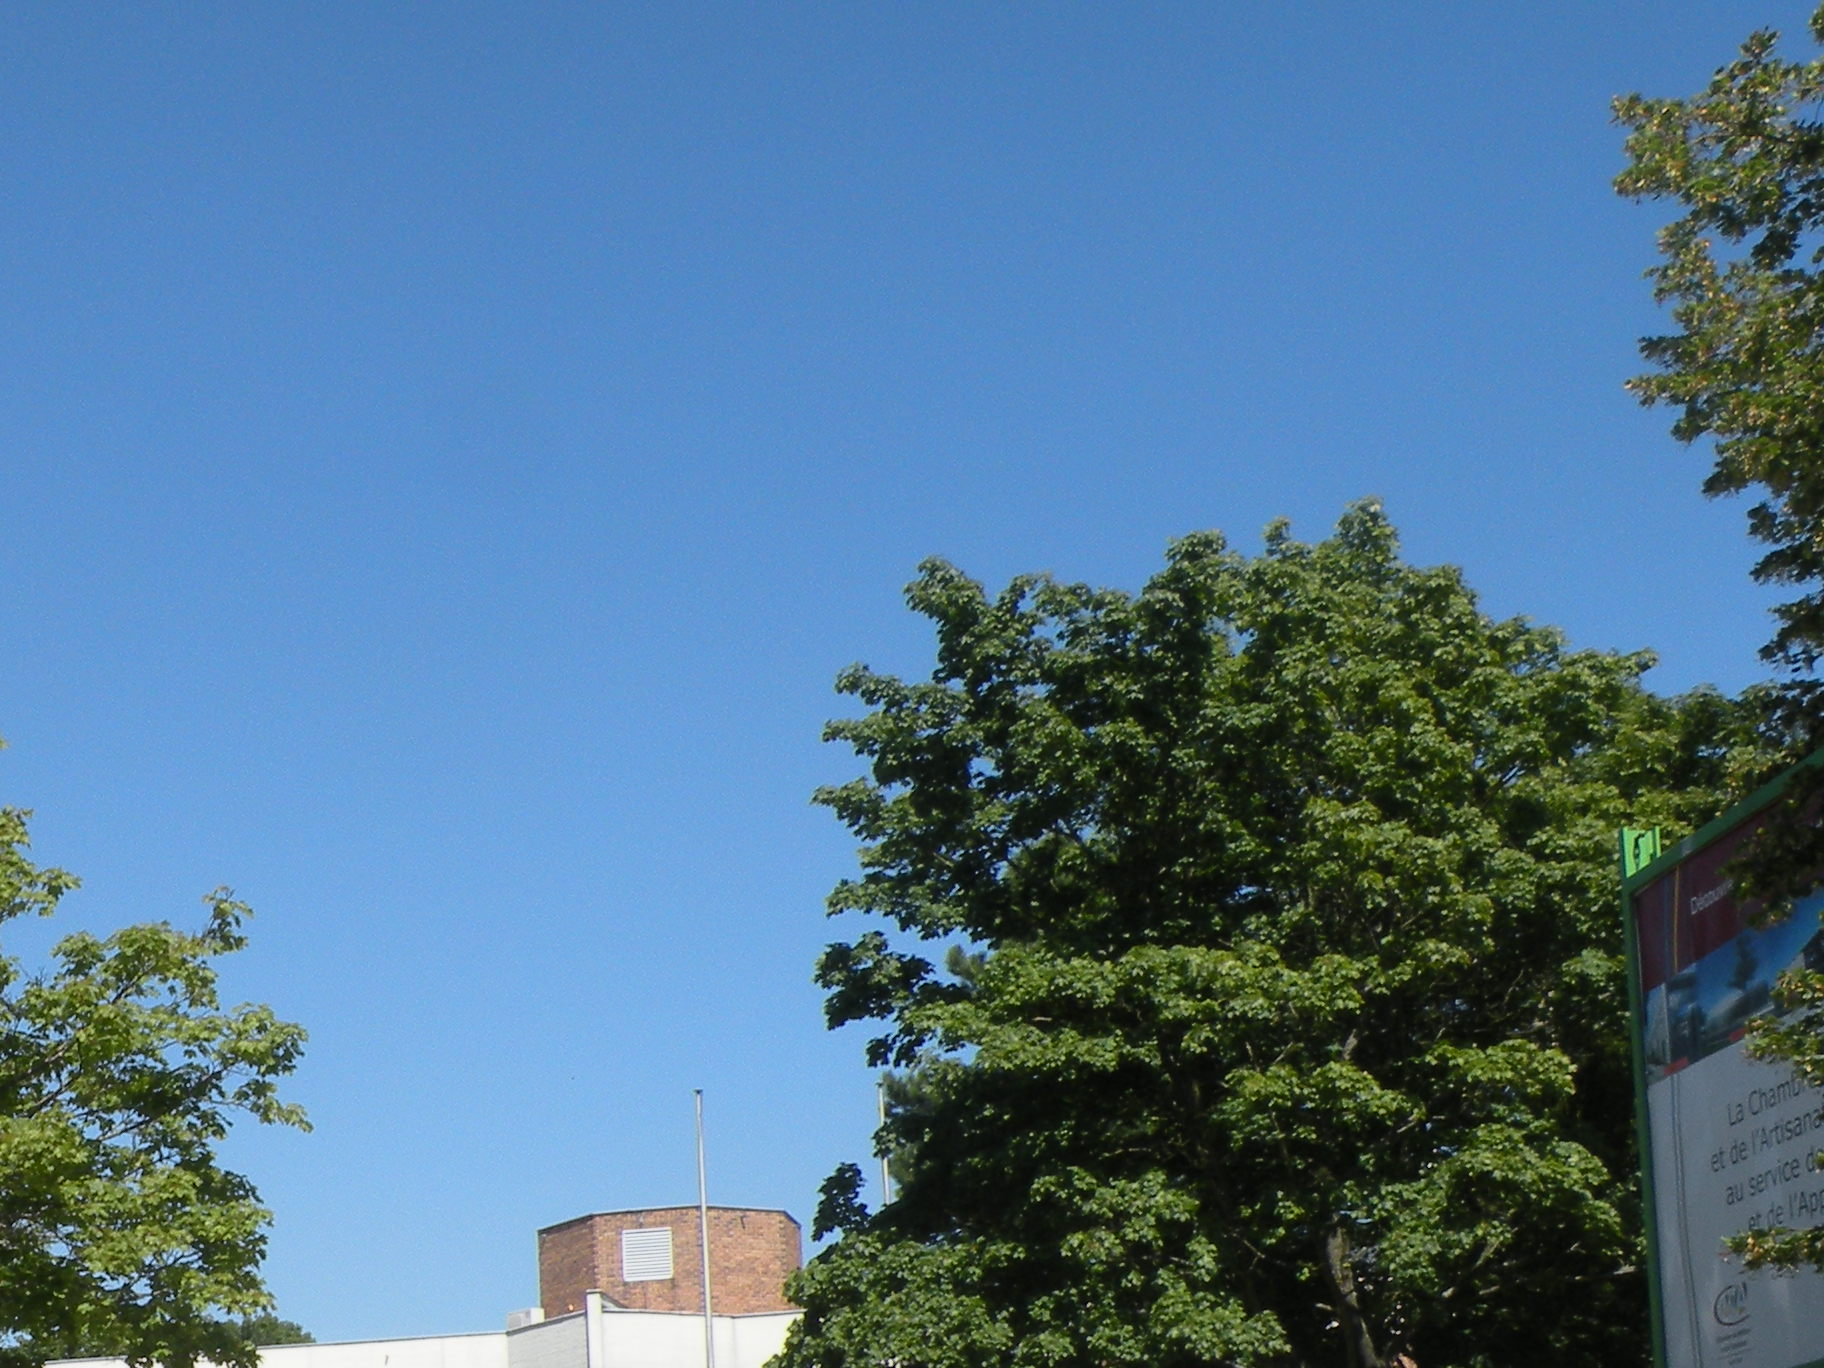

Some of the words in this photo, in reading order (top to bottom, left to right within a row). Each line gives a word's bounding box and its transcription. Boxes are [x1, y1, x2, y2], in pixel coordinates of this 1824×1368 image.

[1727, 1102, 1744, 1126] La
[1748, 1070, 1821, 1116] Chamb
[1710, 1146, 1725, 1172] et
[1729, 1138, 1747, 1165] de
[1725, 1181, 1743, 1206] au
[1748, 1158, 1800, 1197] service
[1767, 1201, 1783, 1228] de
